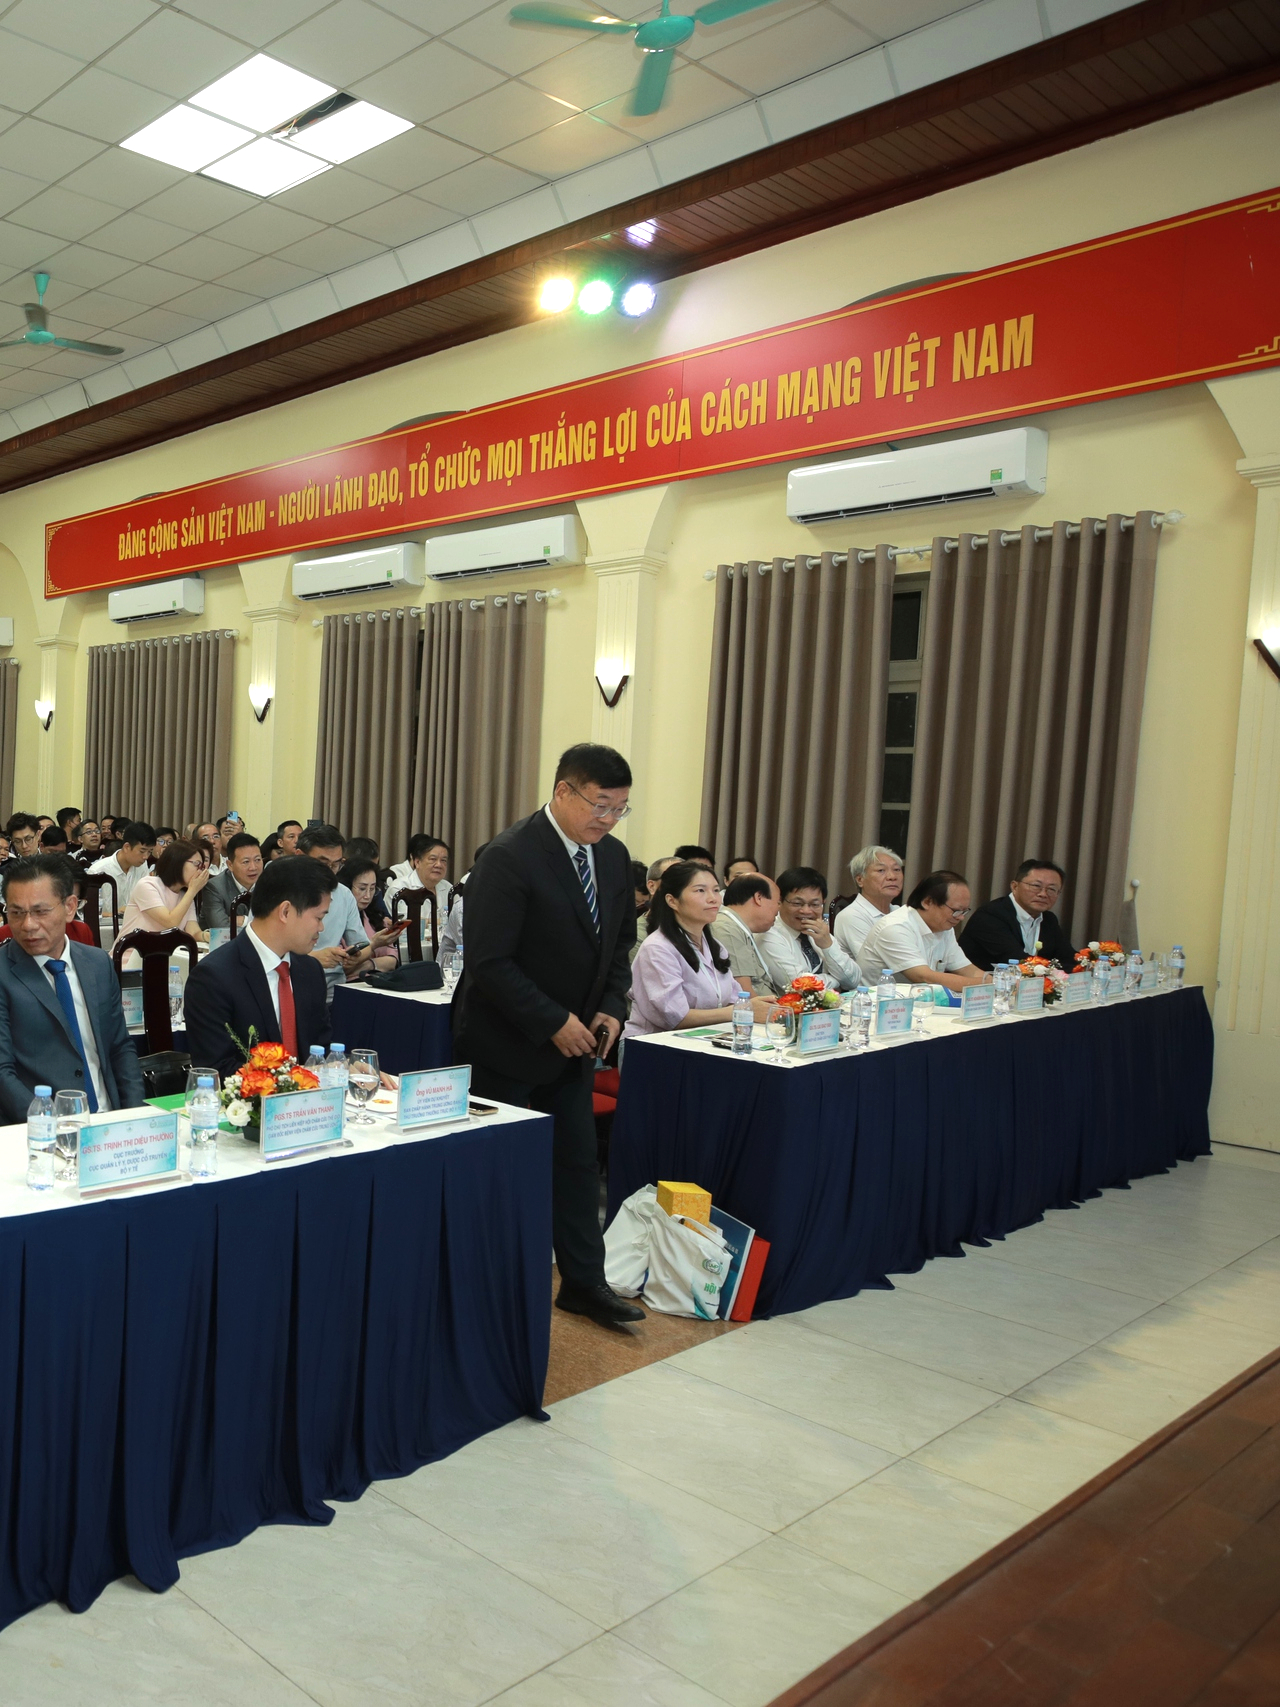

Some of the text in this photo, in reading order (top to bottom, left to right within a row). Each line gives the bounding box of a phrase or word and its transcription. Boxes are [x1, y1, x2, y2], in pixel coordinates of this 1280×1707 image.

[118, 522, 146, 561] ĐẢNG
[149, 518, 178, 559] CỘNG
[181, 506, 205, 547] SẢN
[208, 505, 234, 545] VIỆT
[237, 499, 266, 535] NAM
[278, 479, 320, 527] NGƯỜI
[324, 475, 364, 517] LÃNH
[368, 466, 404, 512] ĐẠO,
[409, 442, 431, 498] TỔ
[434, 440, 481, 494] CHỨC
[487, 438, 522, 487] MỌI
[529, 411, 596, 473] THẮNG
[603, 408, 637, 463] LỢI
[646, 388, 692, 448] CỦA
[700, 377, 768, 437] CÁCH
[777, 356, 862, 424] MẠNG
[873, 332, 941, 403] VIỆT
[952, 314, 1035, 383] NAM
[104, 1142, 122, 1151] TRỊNH
